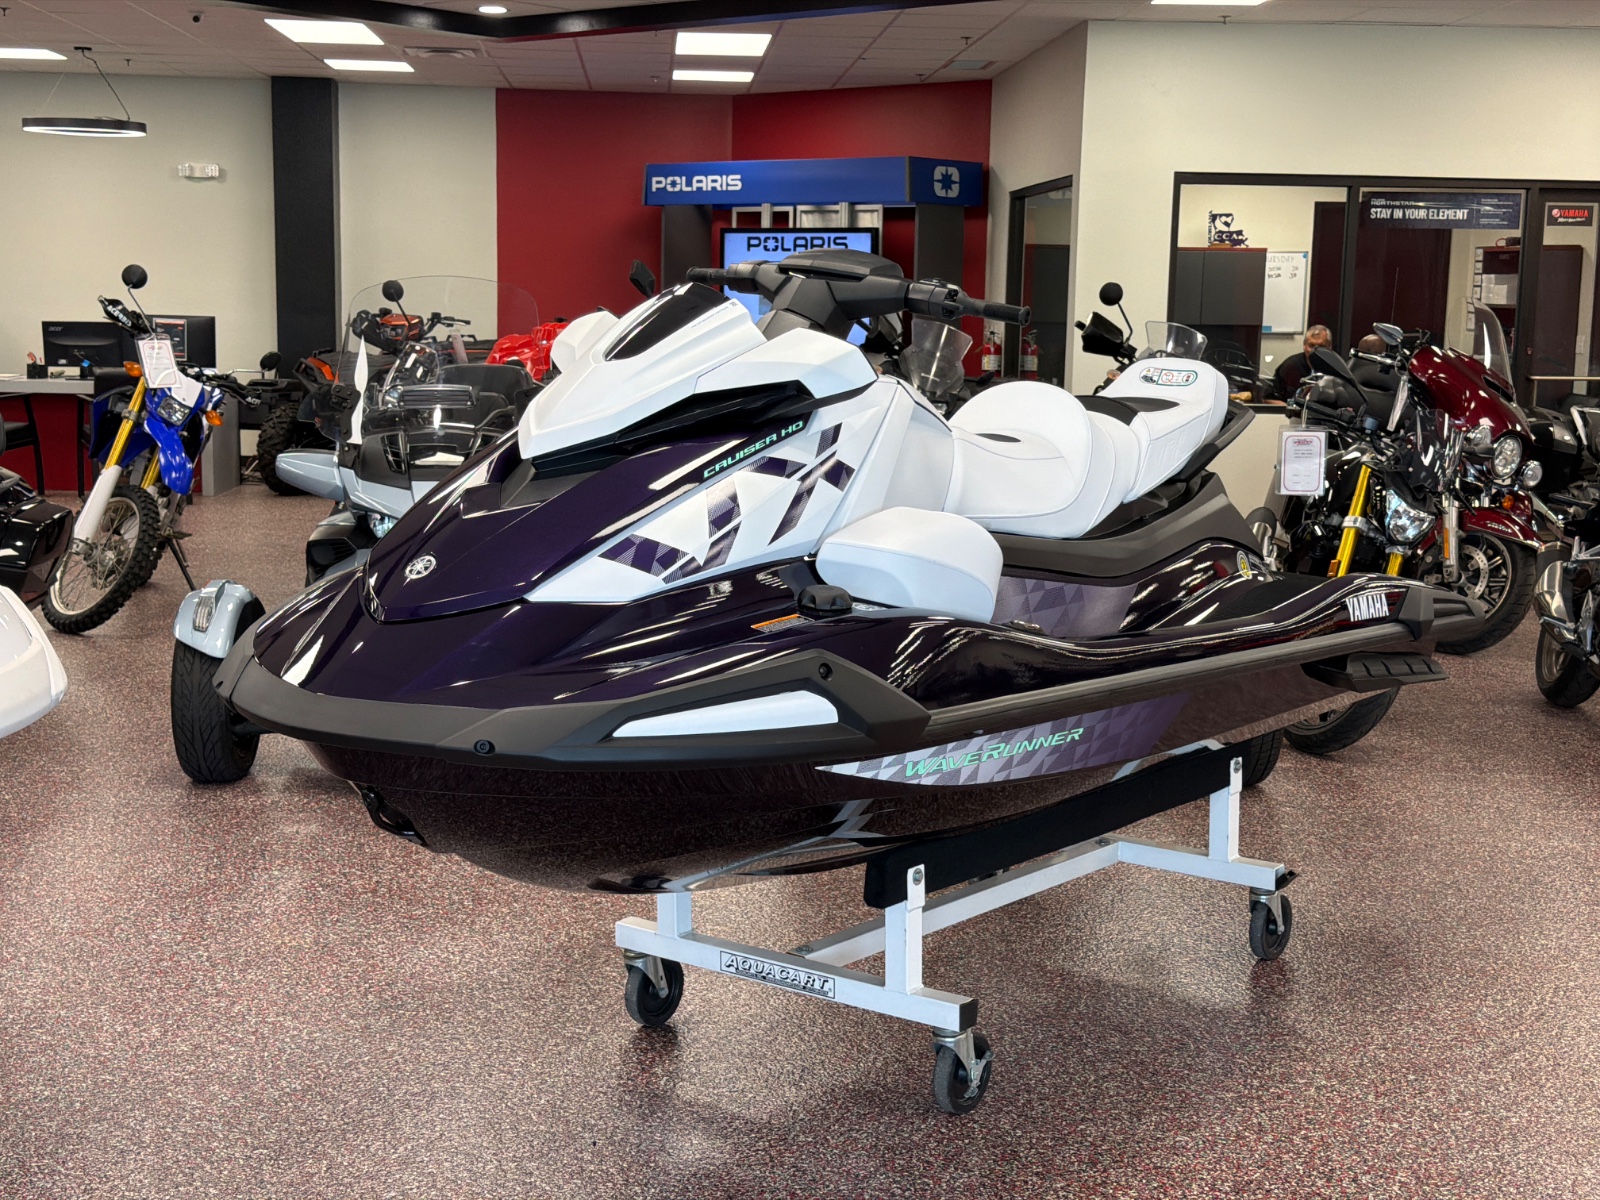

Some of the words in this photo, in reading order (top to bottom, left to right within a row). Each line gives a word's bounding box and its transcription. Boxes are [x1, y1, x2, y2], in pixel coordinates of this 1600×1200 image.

[651, 174, 743, 192] POLARIS
[1370, 207, 1392, 219] STAY
[1393, 208, 1403, 219] IN
[1405, 208, 1428, 220] YOUR
[1428, 208, 1469, 221] ELEMENT
[1560, 209, 1589, 218] YAMAHA
[746, 236, 849, 252] POLARIS
[1214, 232, 1238, 240] CCA
[703, 433, 778, 479] CRUISER
[781, 420, 804, 437] HO
[1345, 593, 1390, 622] YAMAHA
[725, 954, 829, 990] AQUACART
